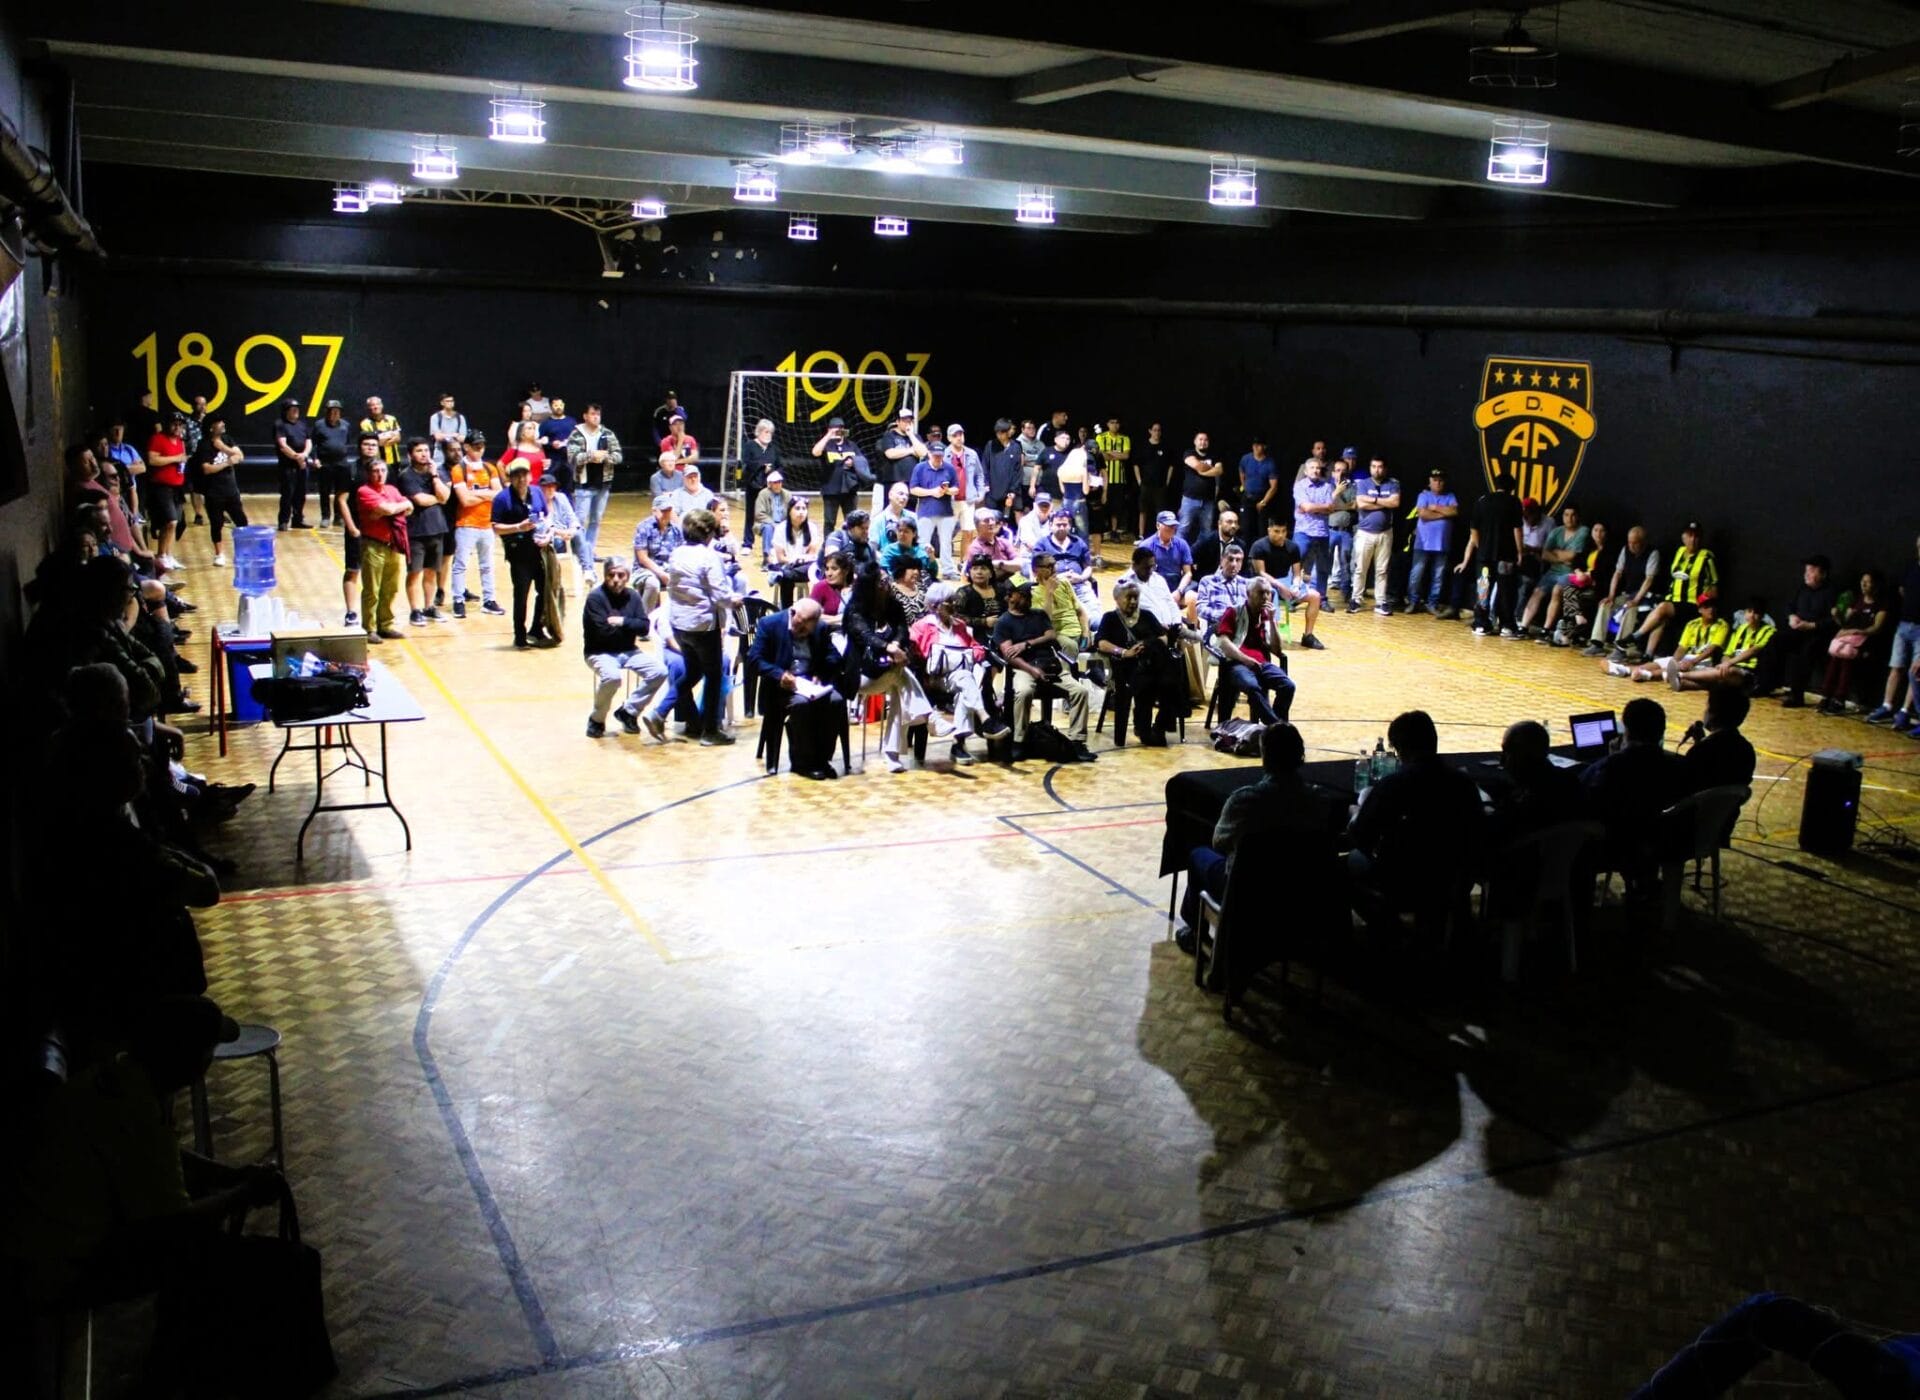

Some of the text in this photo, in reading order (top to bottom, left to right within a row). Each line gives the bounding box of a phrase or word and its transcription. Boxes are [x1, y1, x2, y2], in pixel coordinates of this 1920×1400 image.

[132, 331, 344, 417] 1897
[776, 350, 933, 424] 1903
[1501, 421, 1560, 459] AF
